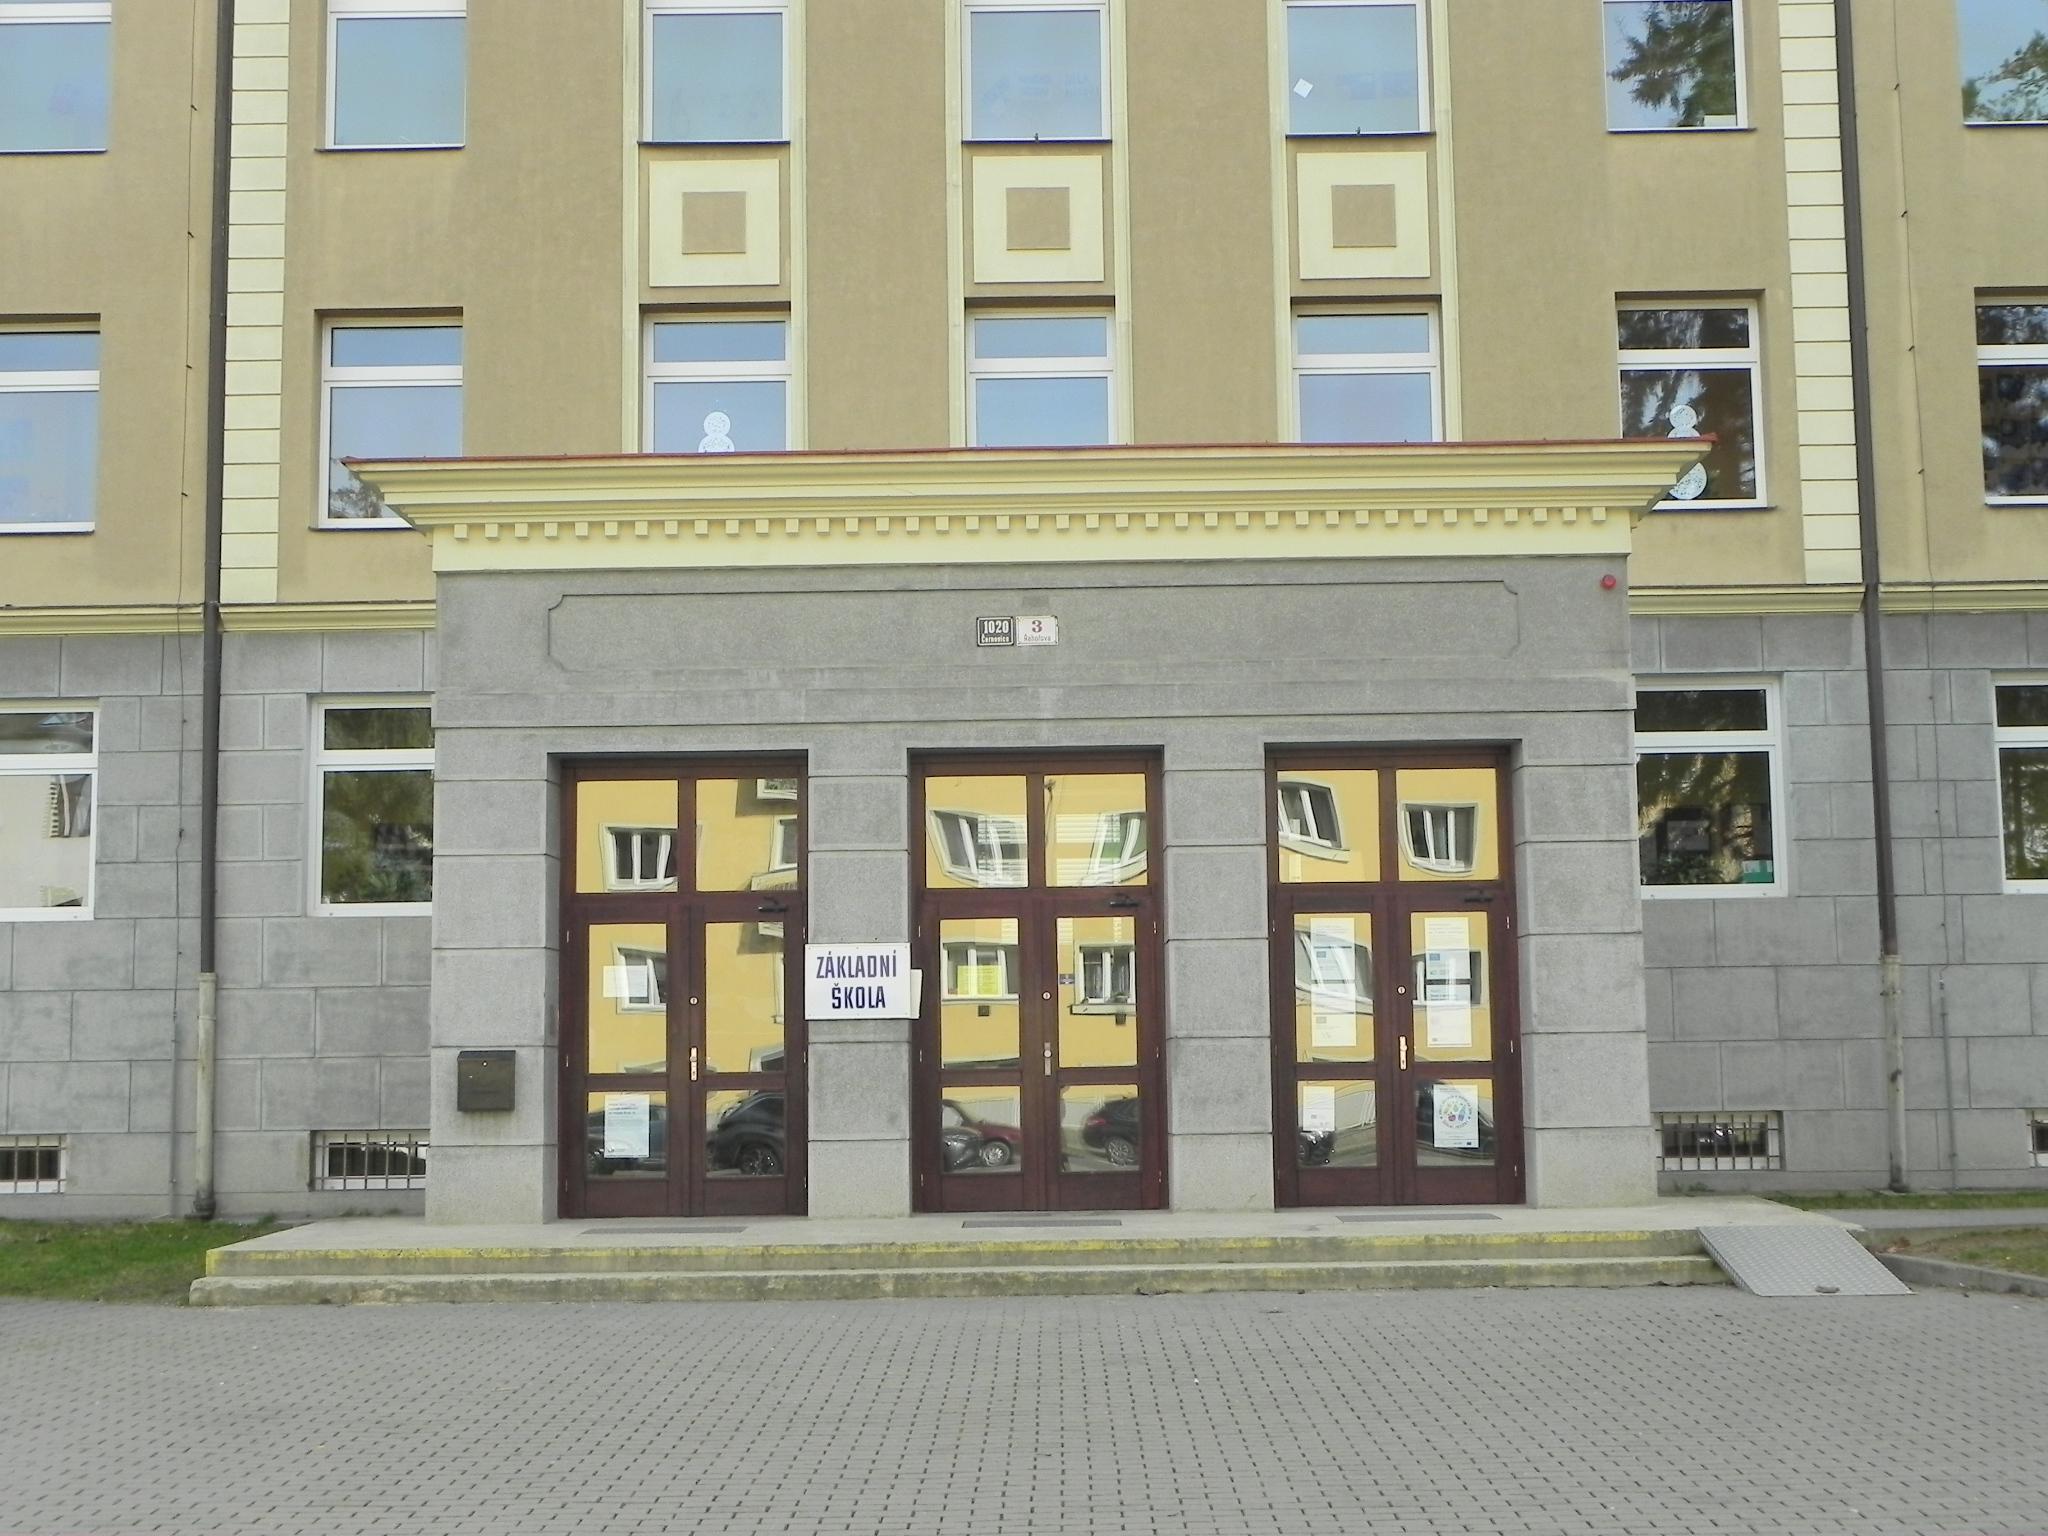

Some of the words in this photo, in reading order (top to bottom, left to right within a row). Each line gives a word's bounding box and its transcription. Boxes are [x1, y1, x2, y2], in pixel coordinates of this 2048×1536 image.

[983, 620, 1009, 633] 1020
[1032, 619, 1042, 633] 3
[816, 949, 897, 979] ZÁKLADNÍ
[831, 982, 886, 1009] ŠKOLA
